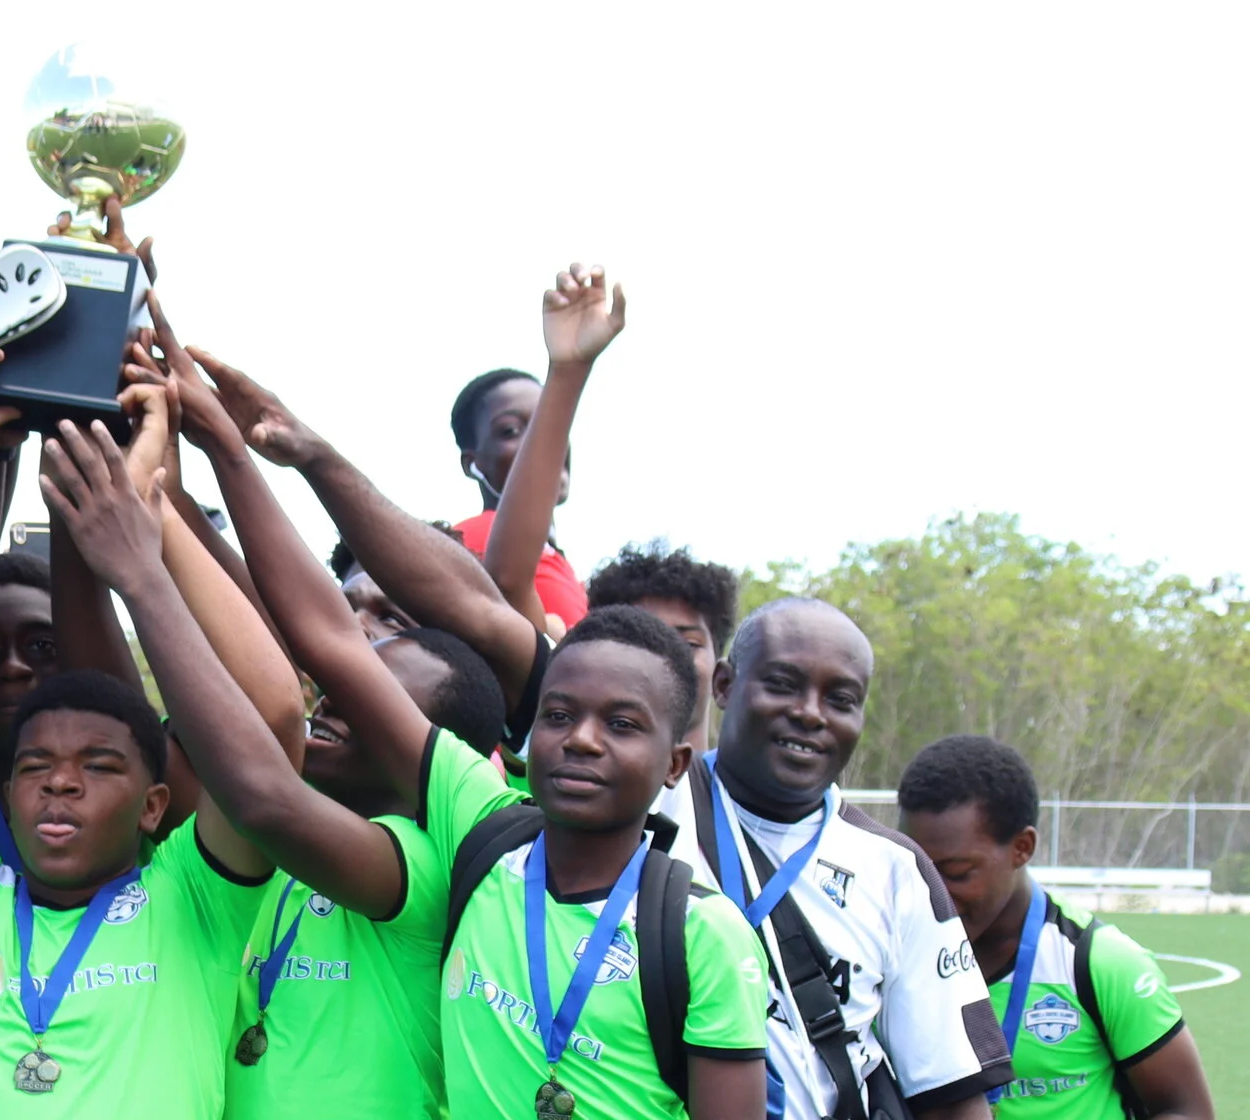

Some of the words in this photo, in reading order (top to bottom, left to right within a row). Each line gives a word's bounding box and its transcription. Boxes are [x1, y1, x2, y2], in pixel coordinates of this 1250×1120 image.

[7, 963, 116, 997] OTIS
[118, 962, 158, 985] TCI
[315, 960, 350, 980] TCI
[467, 971, 543, 1036] FORTI
[1001, 1077, 1047, 1098] TIS
